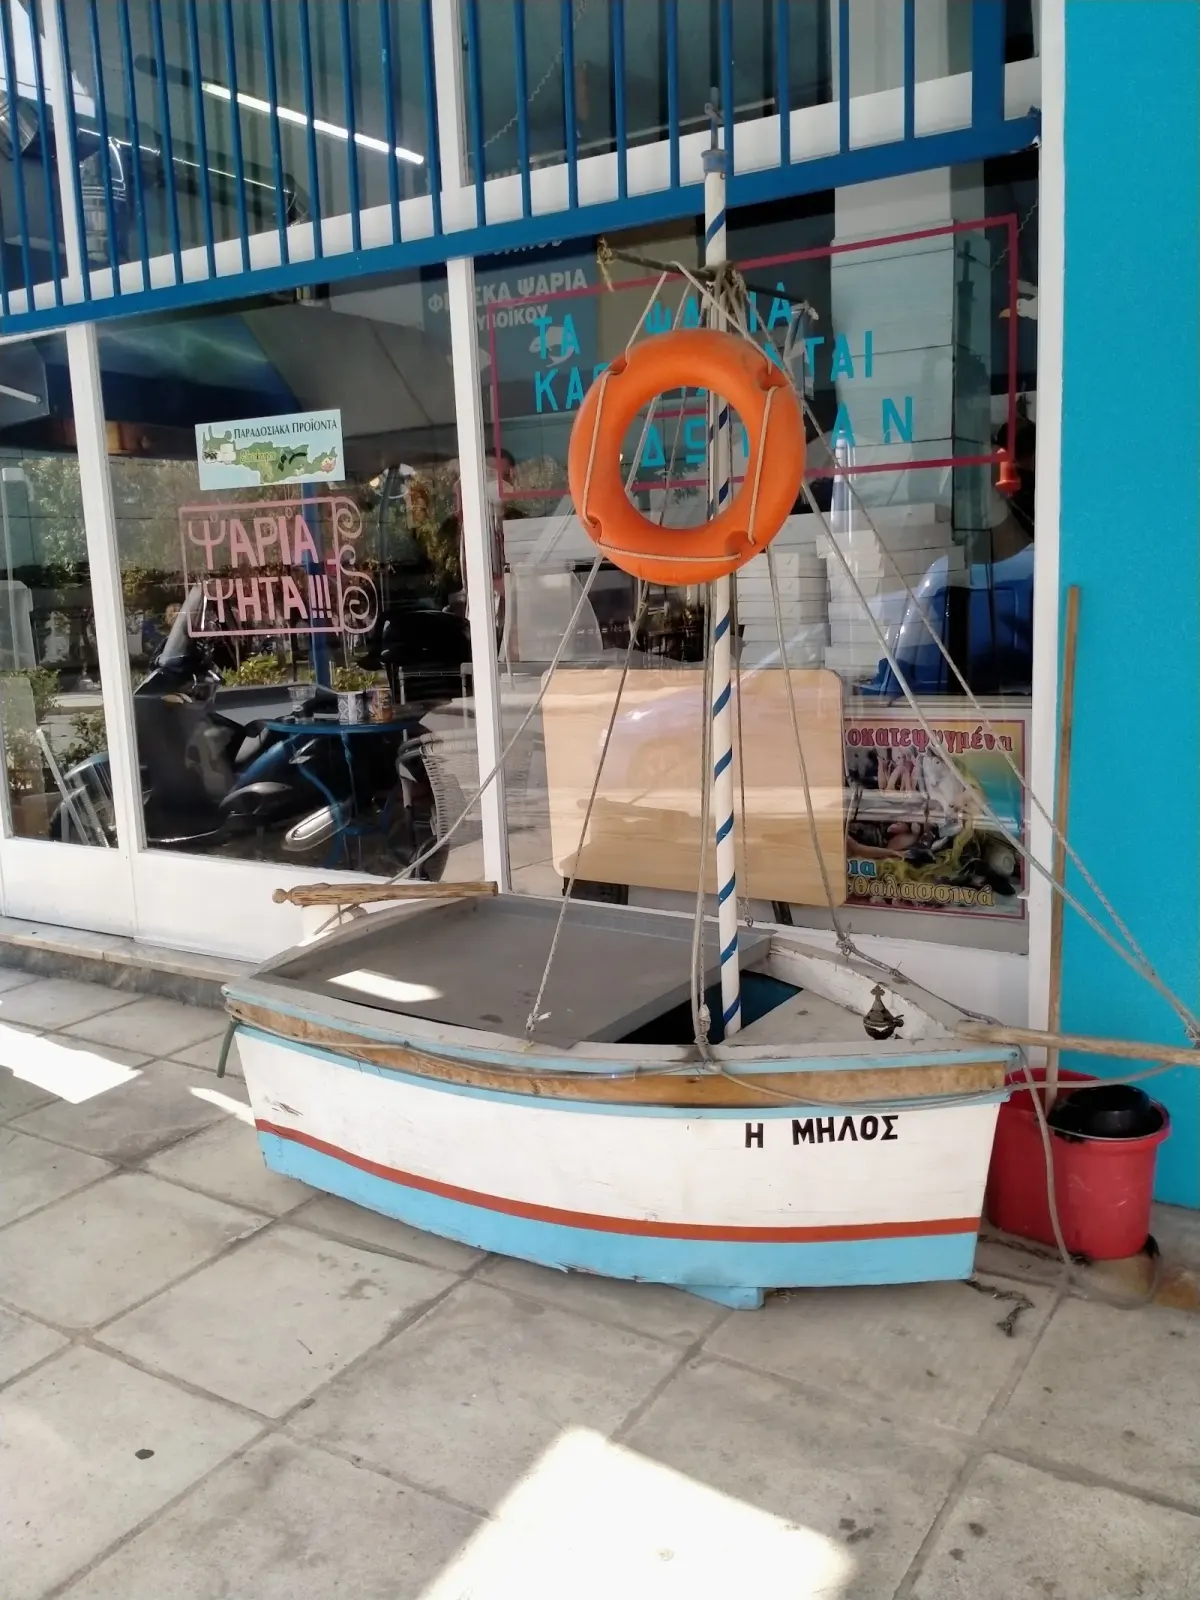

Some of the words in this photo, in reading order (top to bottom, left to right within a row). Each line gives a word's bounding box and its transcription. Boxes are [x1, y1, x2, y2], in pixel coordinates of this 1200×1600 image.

[517, 268, 588, 298] ΨΑΡΙΑ
[534, 313, 580, 360] ΤΑ
[643, 281, 794, 335] ΨΑΙΑ
[233, 425, 291, 439] ΠΑΡΑΔΟΣΙΑΚΑ
[292, 418, 338, 433] ΠΡΟΪΟΝΤΑ
[187, 514, 319, 570] ΨΑΡΙΑ
[853, 874, 995, 908] θαλασσινά
[745, 1122, 764, 1149] Η
[791, 1115, 899, 1146] ΜΗΛΟΣ
